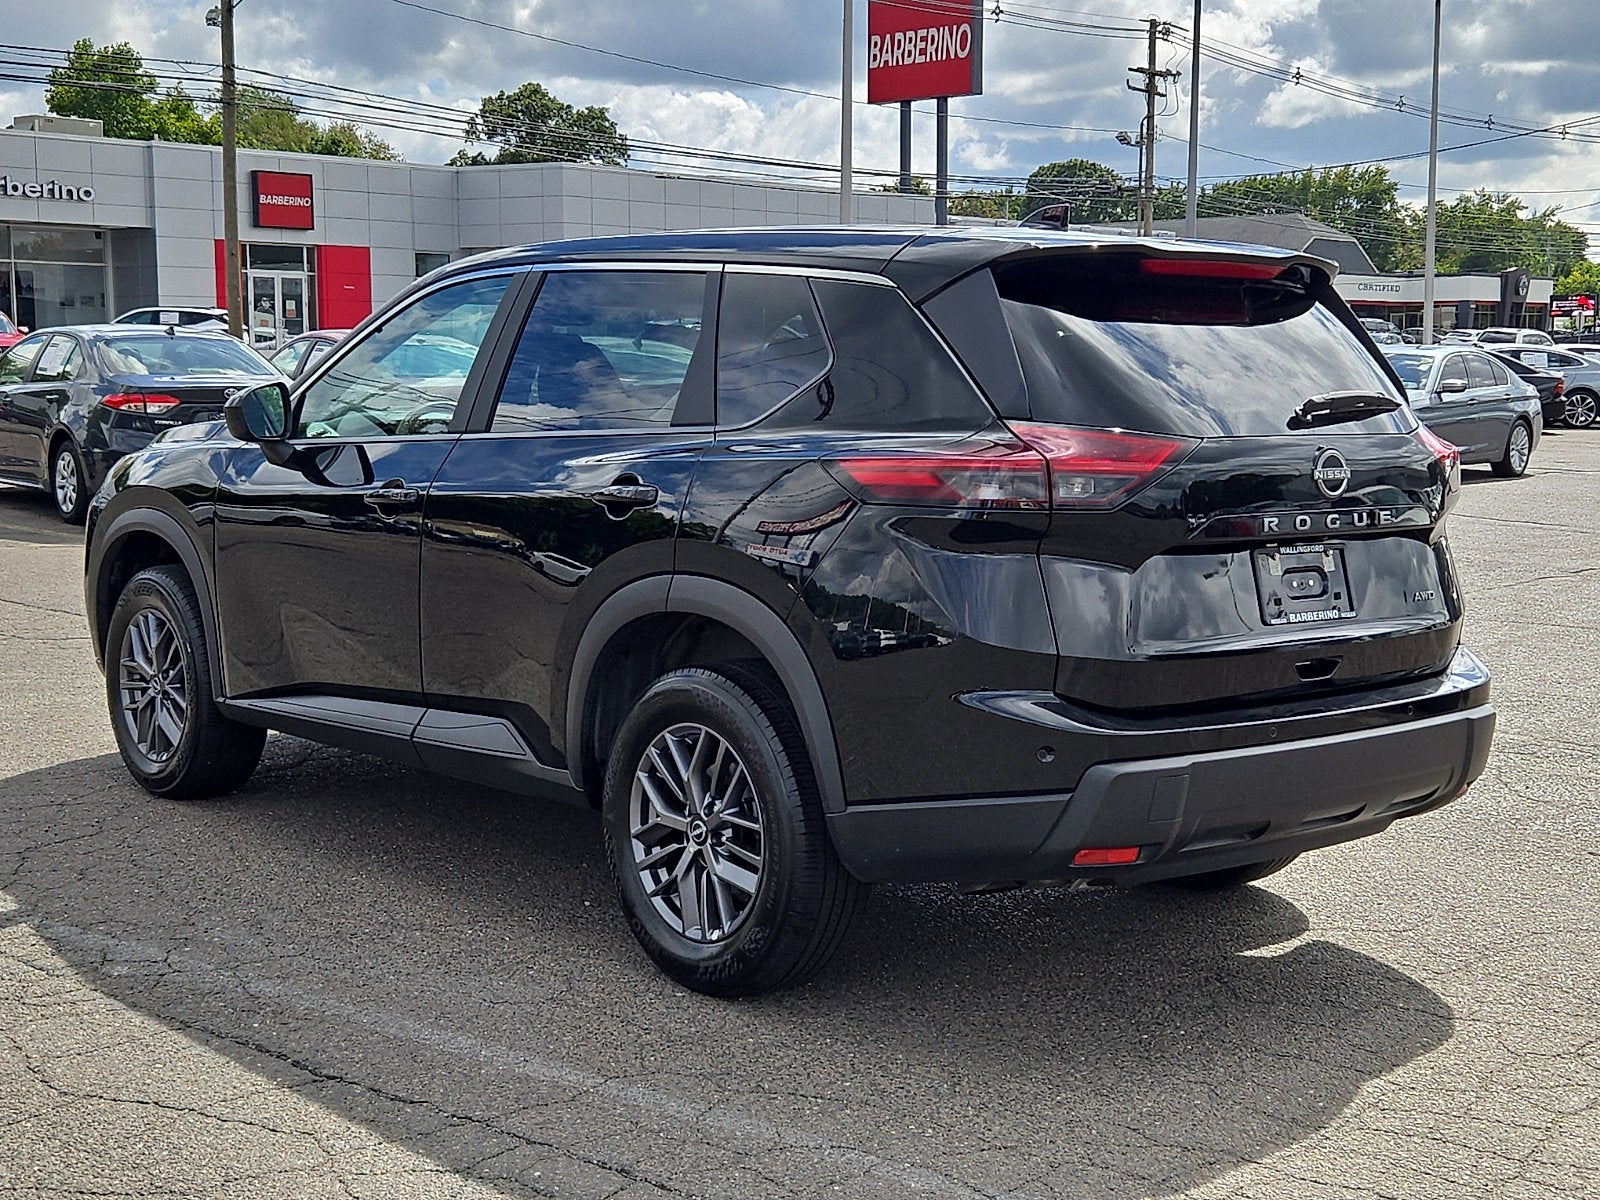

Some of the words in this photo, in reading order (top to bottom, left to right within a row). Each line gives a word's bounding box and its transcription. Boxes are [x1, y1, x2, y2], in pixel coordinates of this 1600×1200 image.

[869, 22, 972, 70] BARBERINO
[259, 194, 312, 207] BARBERINO
[1357, 283, 1401, 292] CERTIFIED
[1315, 469, 1351, 481] NISSAN
[1263, 510, 1393, 532] ROGUE
[1279, 545, 1324, 554] WALLINGFORD
[1413, 590, 1436, 602] AWD
[1289, 609, 1338, 622] BARBERINO
